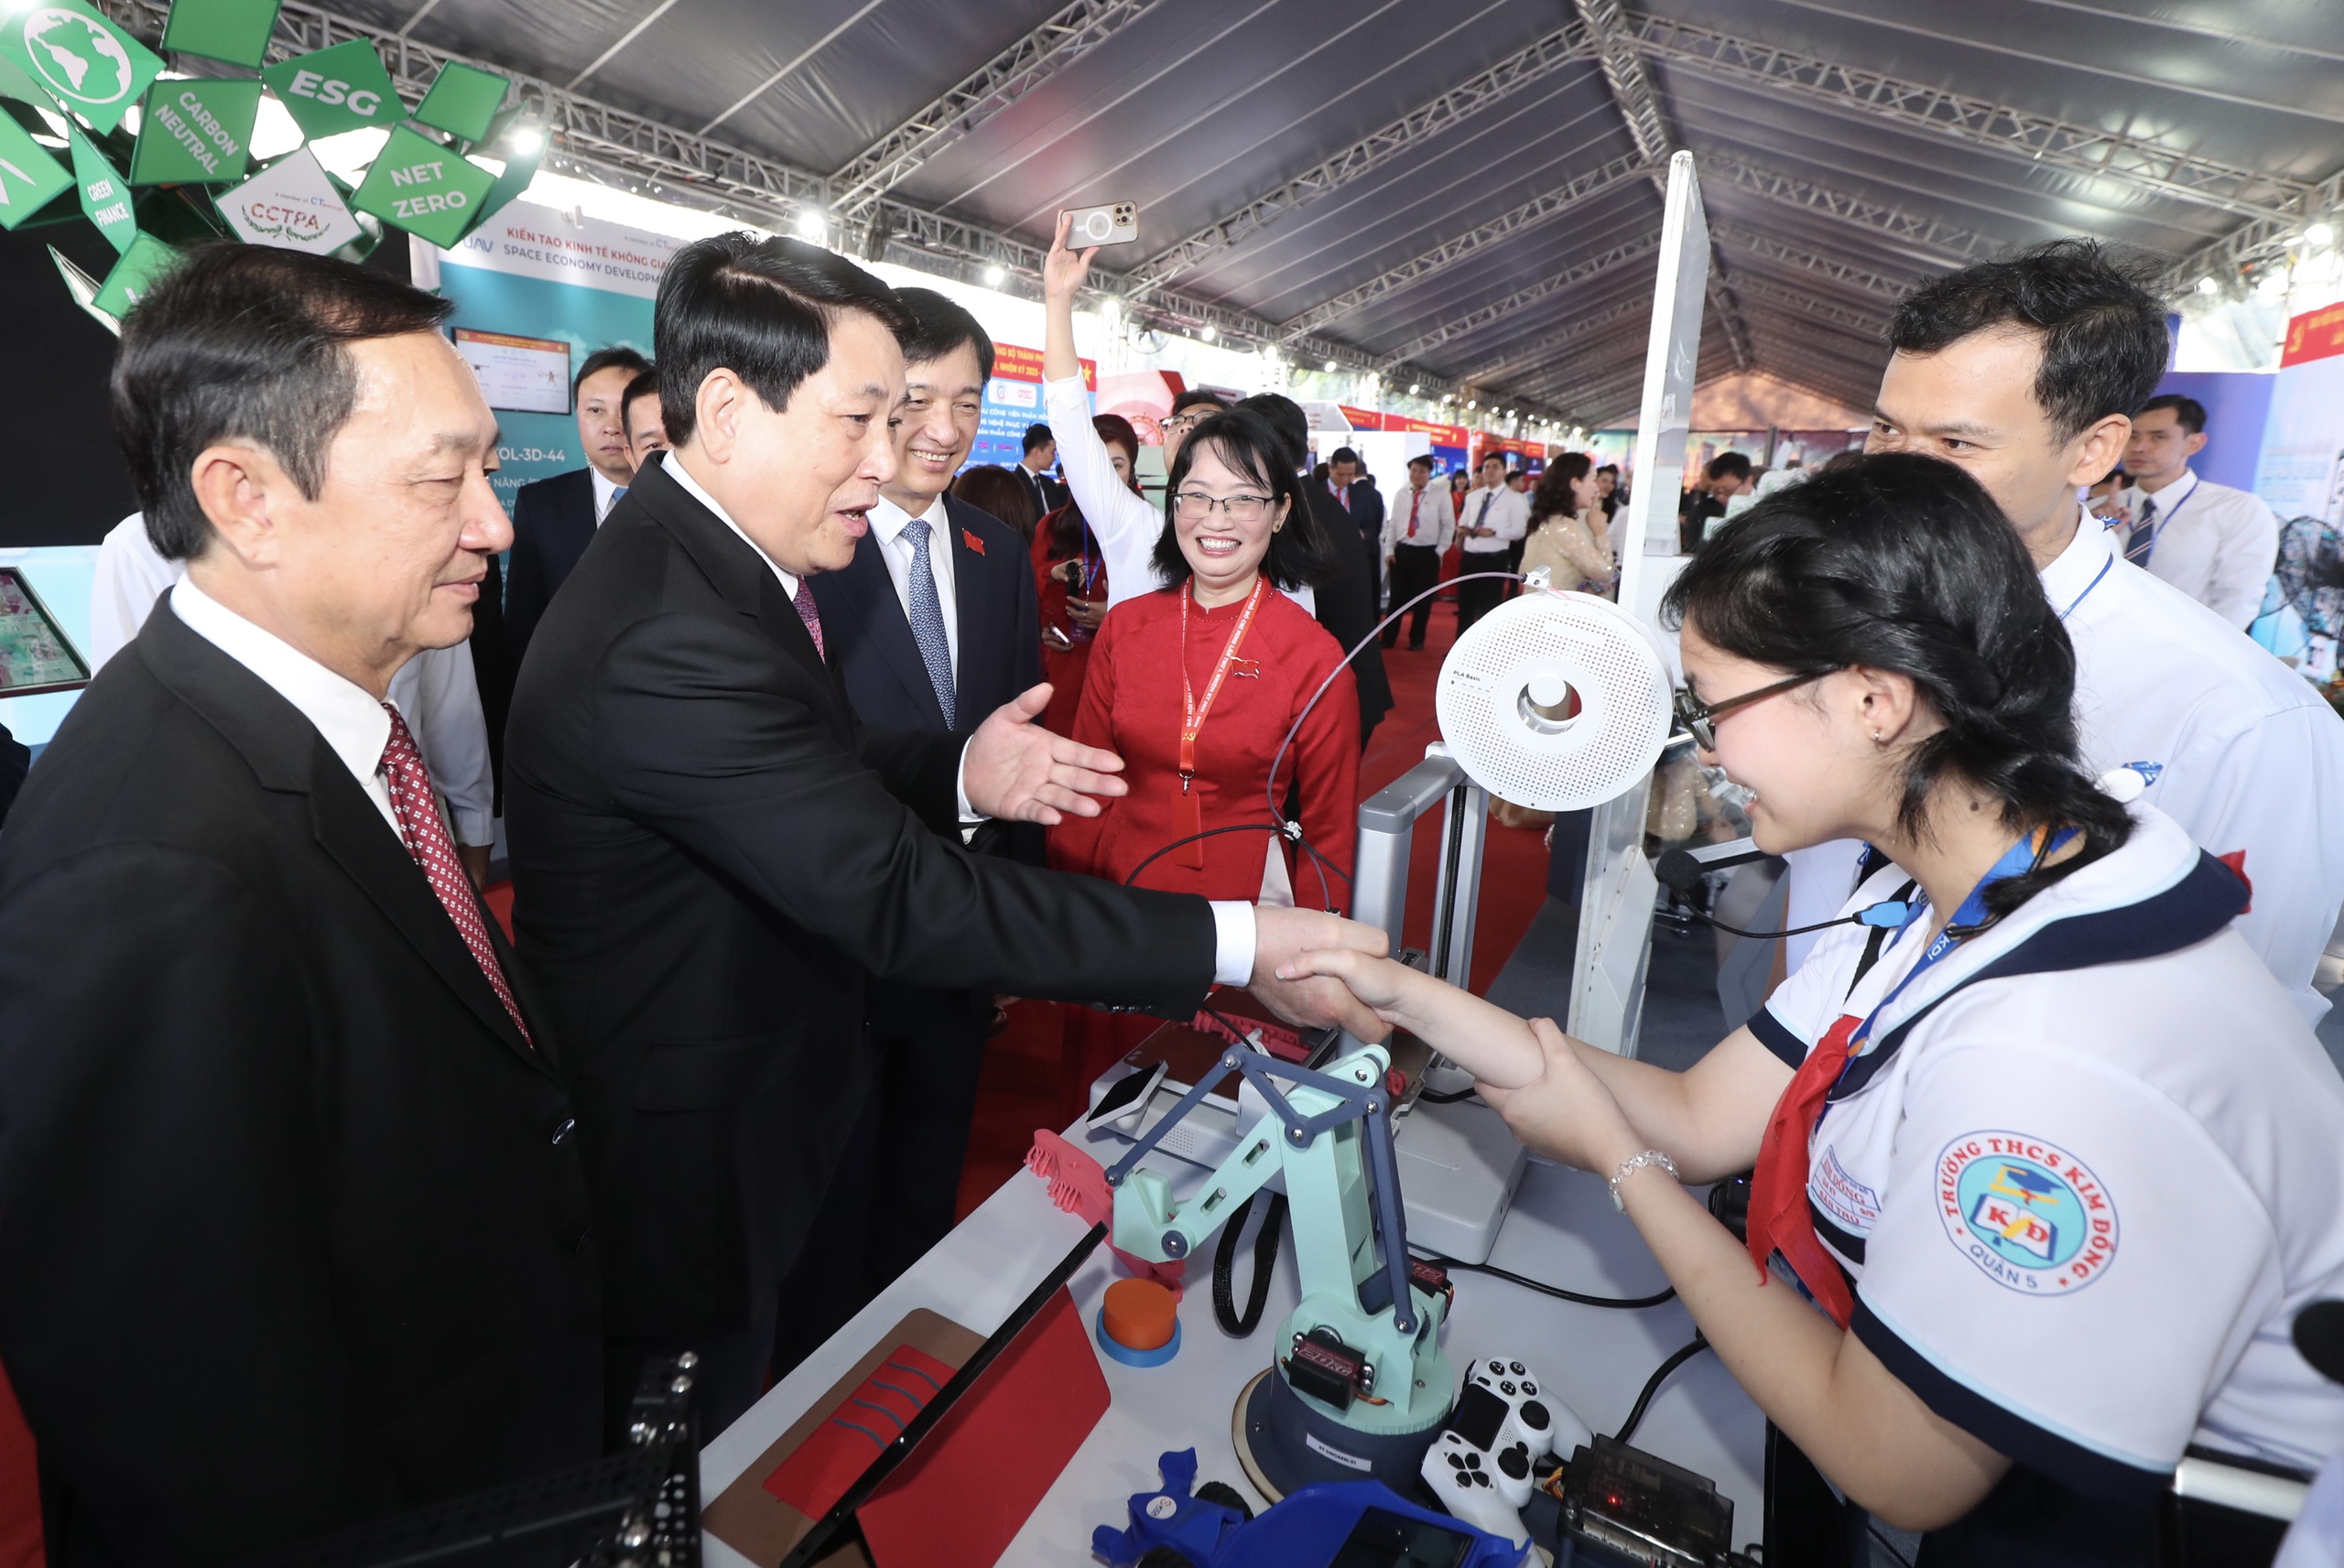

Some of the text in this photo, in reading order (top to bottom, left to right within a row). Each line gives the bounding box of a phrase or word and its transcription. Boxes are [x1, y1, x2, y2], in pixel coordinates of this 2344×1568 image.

[288, 69, 382, 116] ESG
[154, 103, 219, 175] NEUTRAL
[179, 92, 239, 157] CARBON
[390, 161, 443, 187] NET
[87, 178, 114, 202] GREEN
[392, 190, 467, 219] ZERO
[94, 201, 129, 227] FINANCE
[251, 202, 320, 230] CCTPA
[507, 226, 535, 242] KIẾN
[565, 240, 592, 254] KINH
[595, 244, 608, 257] TẾ
[611, 250, 647, 266] KHÔNG
[504, 243, 659, 284] SPACE ECONOMY DEVELOPM
[497, 448, 565, 461] OL-3D-44
[1941, 1141, 1981, 1217] TRƯỜNG
[1988, 1139, 2062, 1168] THCS
[2065, 1166, 2107, 1210] KIM
[2026, 1275, 2037, 1289] 5
